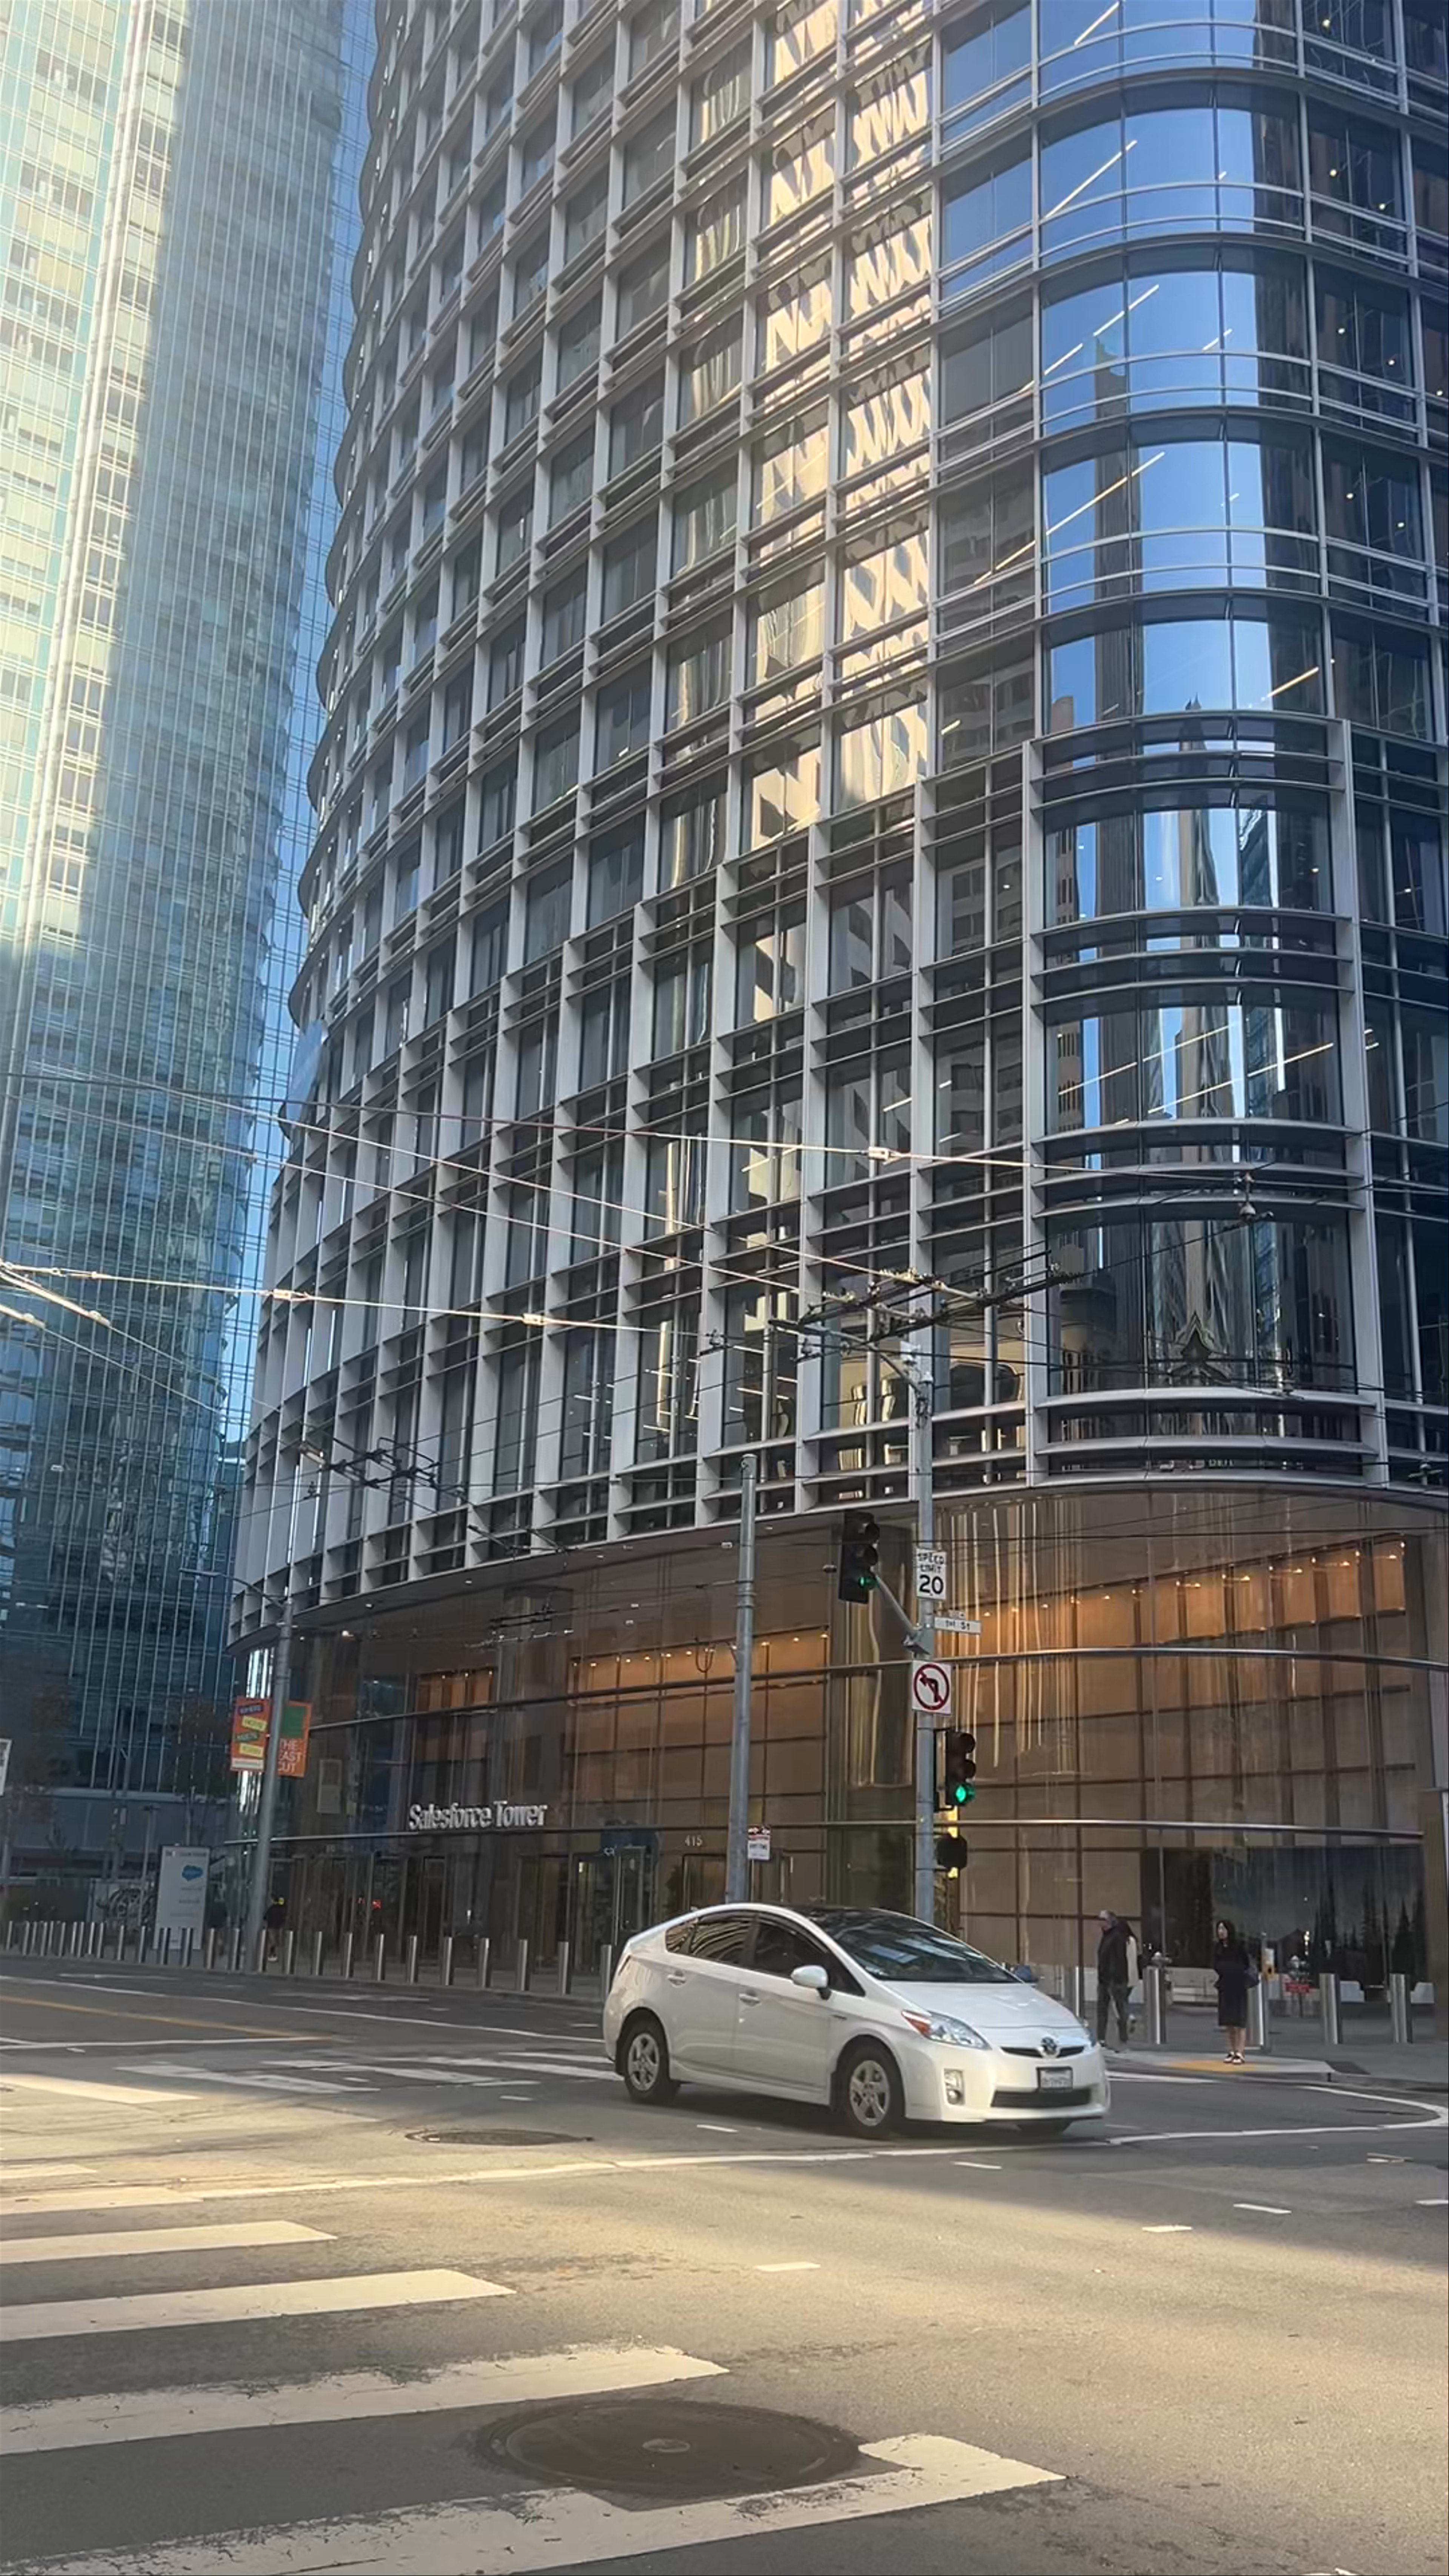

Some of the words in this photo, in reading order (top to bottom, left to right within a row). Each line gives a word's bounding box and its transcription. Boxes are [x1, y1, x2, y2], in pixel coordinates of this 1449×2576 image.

[918, 1552, 944, 1564] SPEED
[921, 1564, 941, 1573] LIMIT
[919, 1574, 944, 1595] 20
[409, 1802, 491, 1830] Salesforce
[493, 1801, 548, 1827] Tower
[685, 1835, 703, 1846] 415
